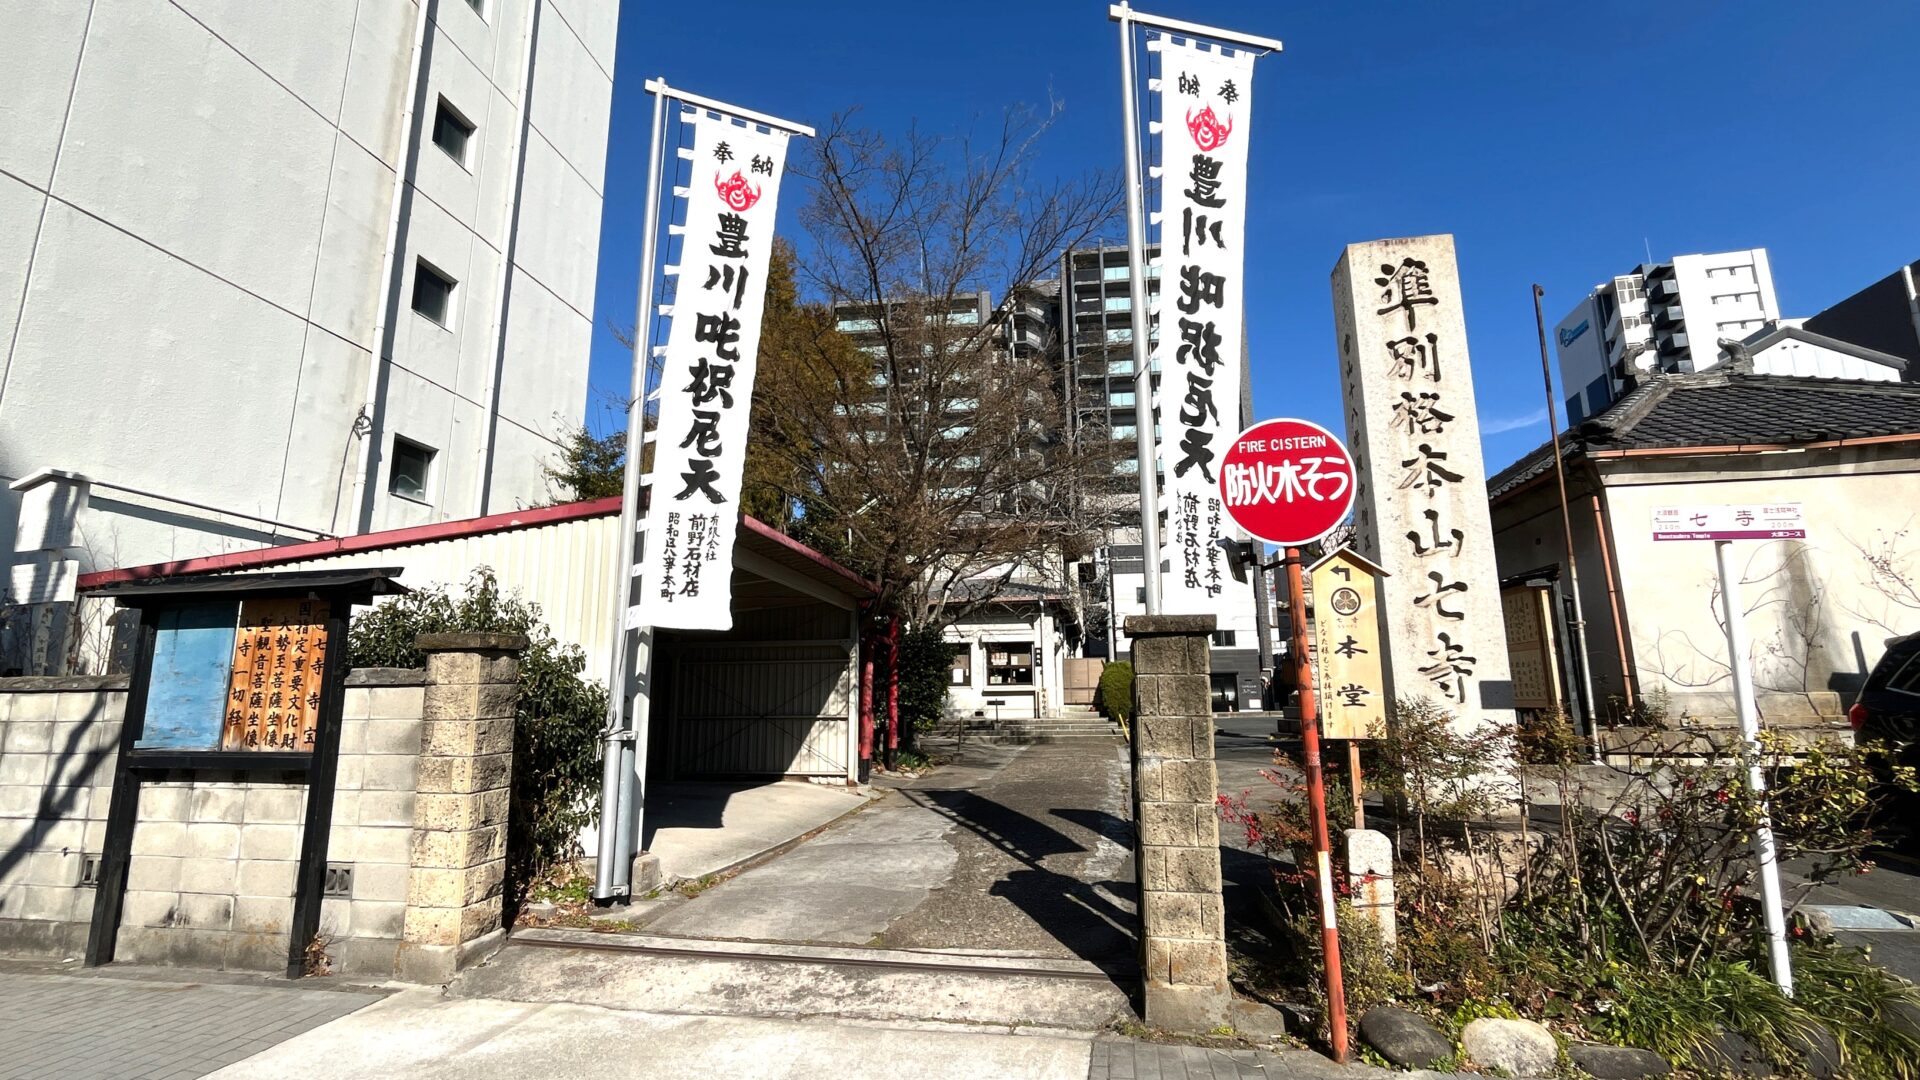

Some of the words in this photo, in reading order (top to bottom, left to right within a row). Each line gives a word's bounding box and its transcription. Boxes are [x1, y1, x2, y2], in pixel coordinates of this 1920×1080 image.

[713, 141, 774, 177] 奉納
[1238, 440, 1267, 453] FIRE
[1270, 435, 1327, 451] CISTERN
[1224, 456, 1349, 506] 防火水そう
[705, 512, 720, 561] 有限会社
[1689, 509, 1754, 527] 七寺
[660, 512, 681, 602] 昭和区八事本町
[678, 513, 708, 597] 前野石材店
[1334, 634, 1370, 707] 本堂
